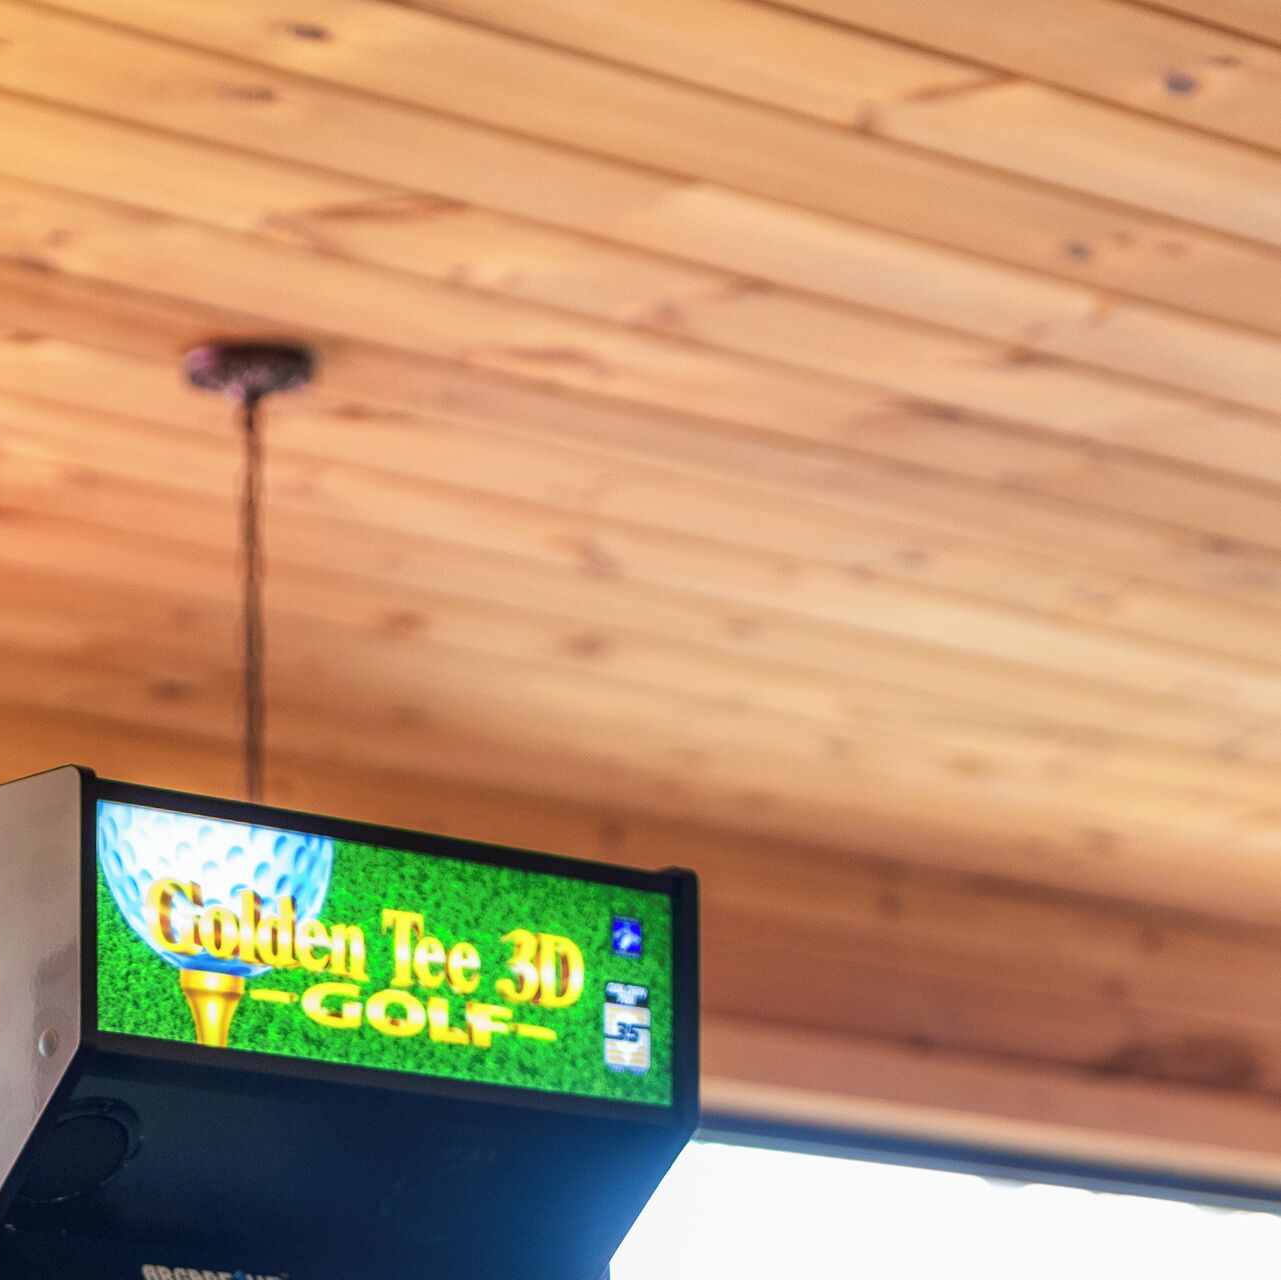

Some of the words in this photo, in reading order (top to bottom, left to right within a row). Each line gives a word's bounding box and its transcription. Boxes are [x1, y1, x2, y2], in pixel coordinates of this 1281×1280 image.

[146, 876, 369, 983] Golden
[381, 908, 481, 994] Tee
[495, 928, 585, 1008] 3D
